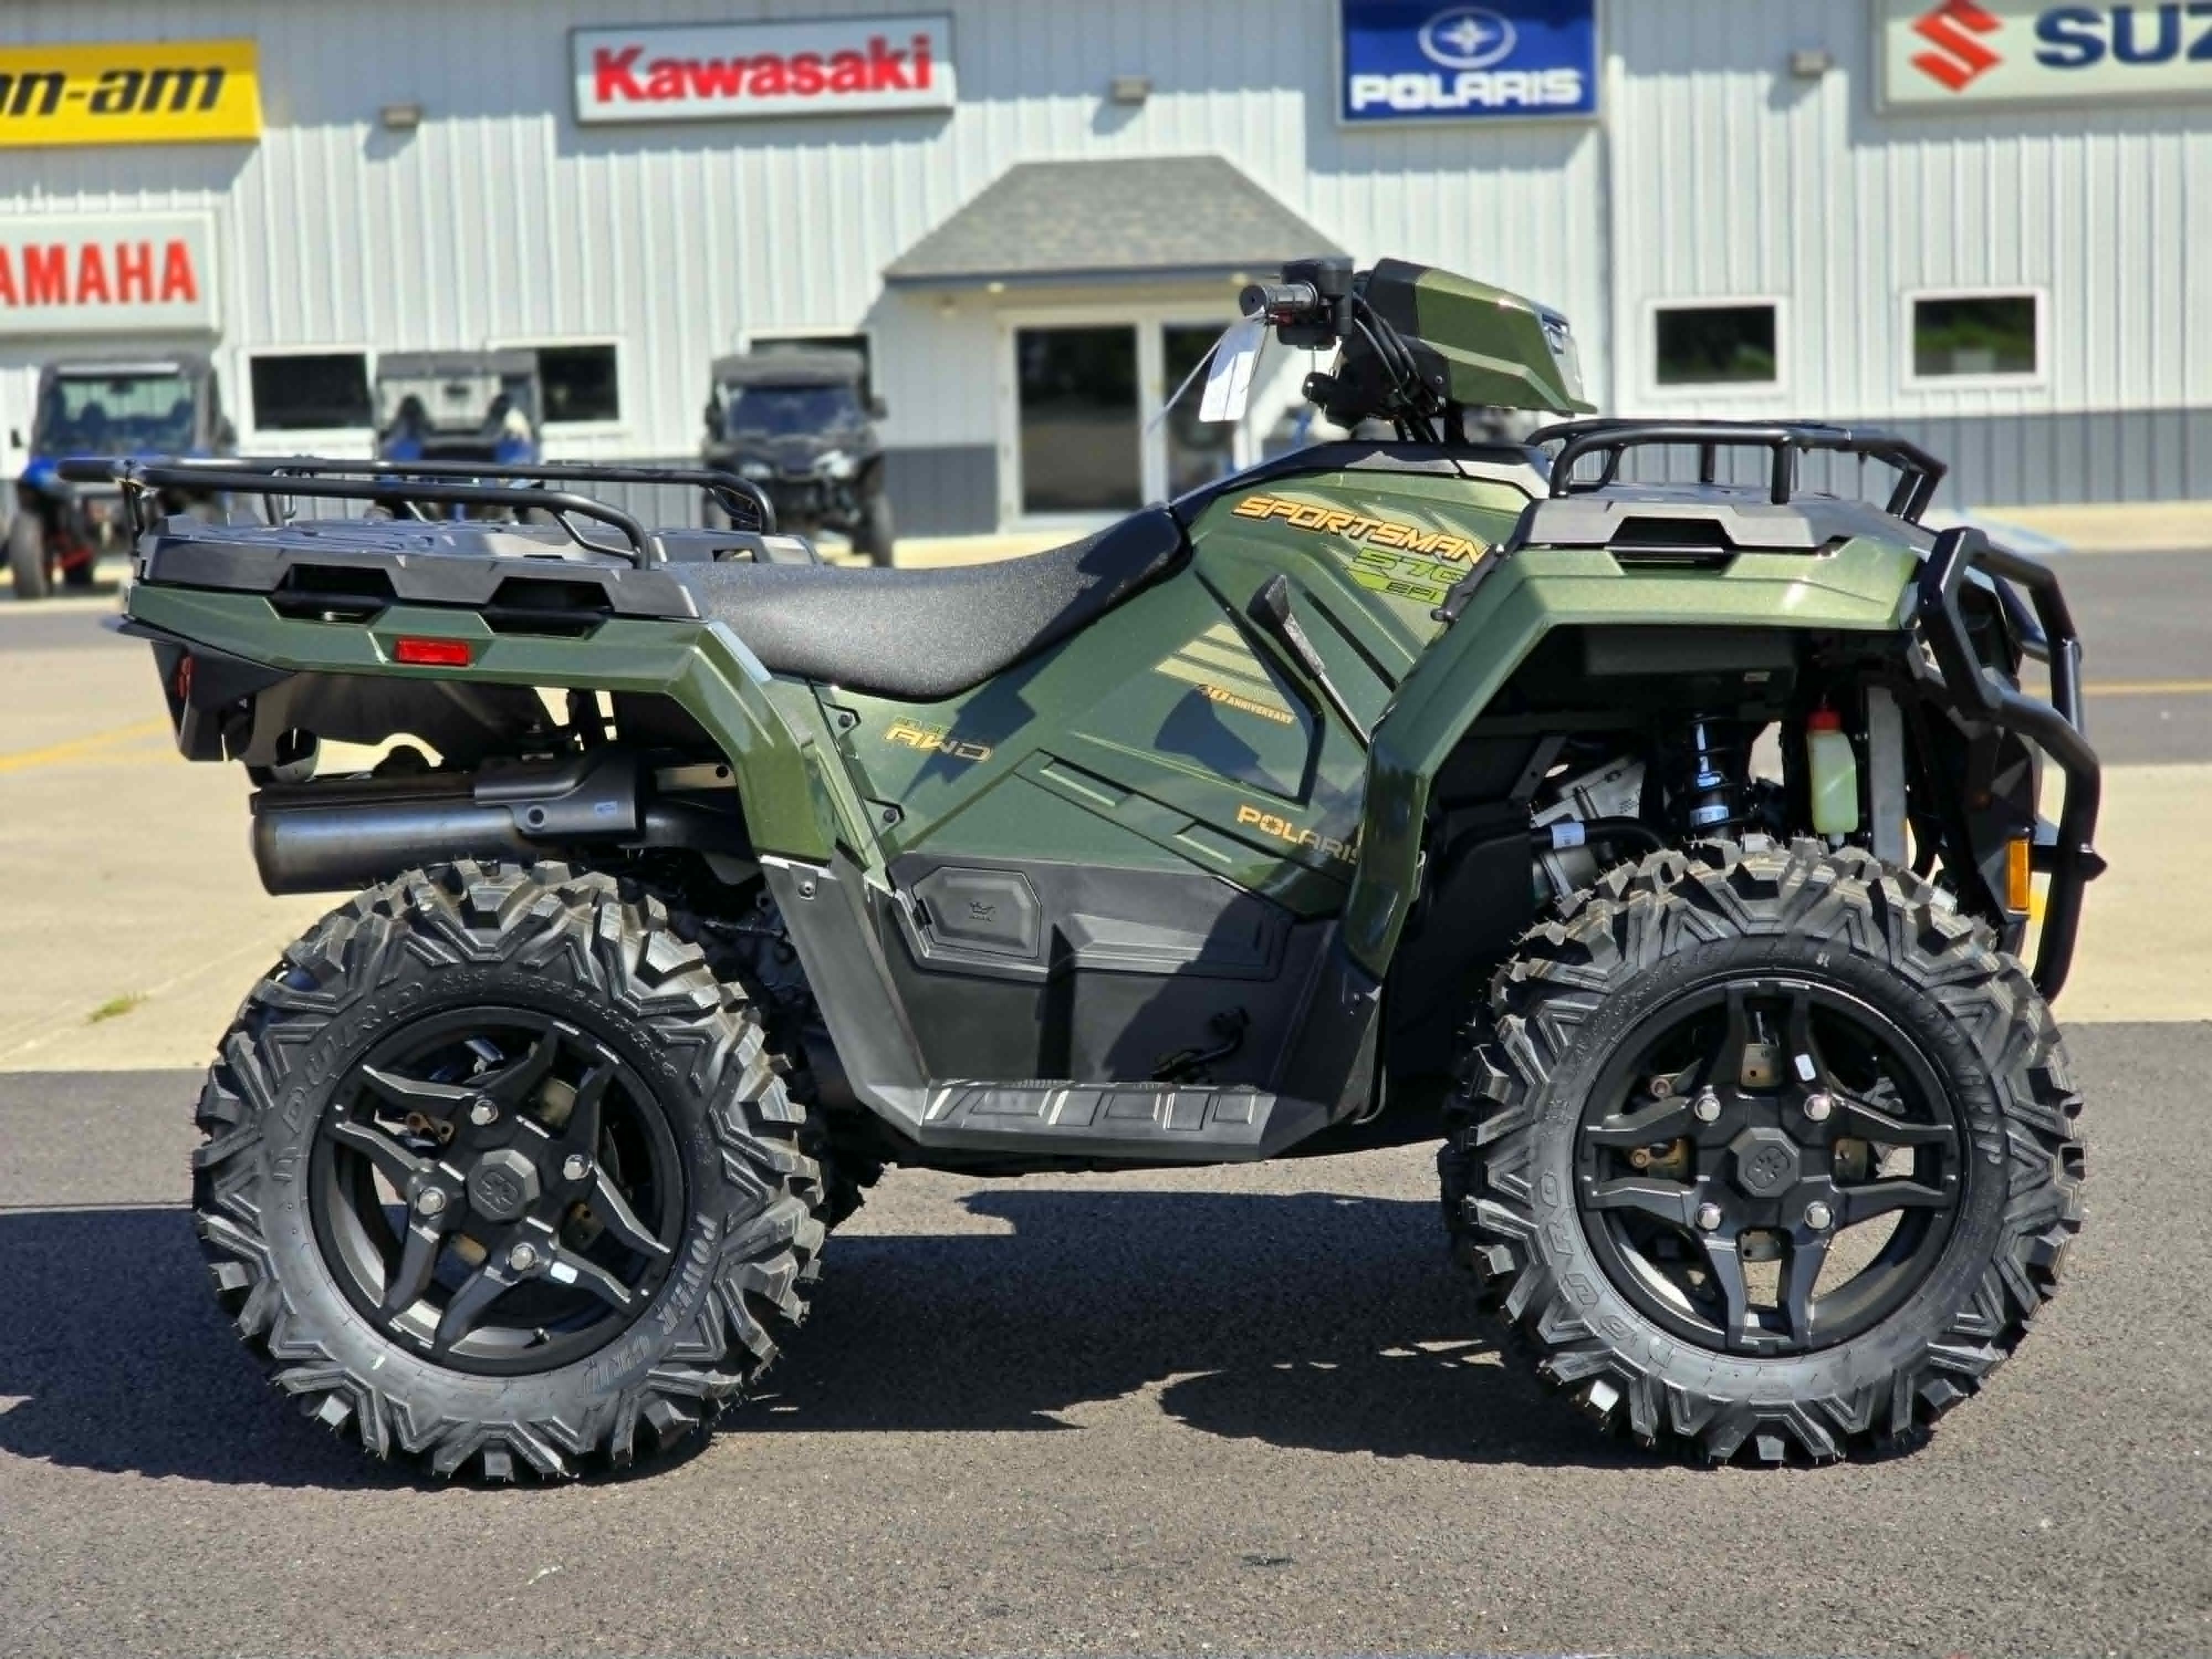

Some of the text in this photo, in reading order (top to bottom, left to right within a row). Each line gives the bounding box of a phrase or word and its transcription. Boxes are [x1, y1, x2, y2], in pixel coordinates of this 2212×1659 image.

[0, 66, 225, 116] n-am
[592, 34, 932, 103] Kawasaki
[1350, 68, 1583, 111] POLARIS
[1231, 495, 1490, 563] SPORTSMAN
